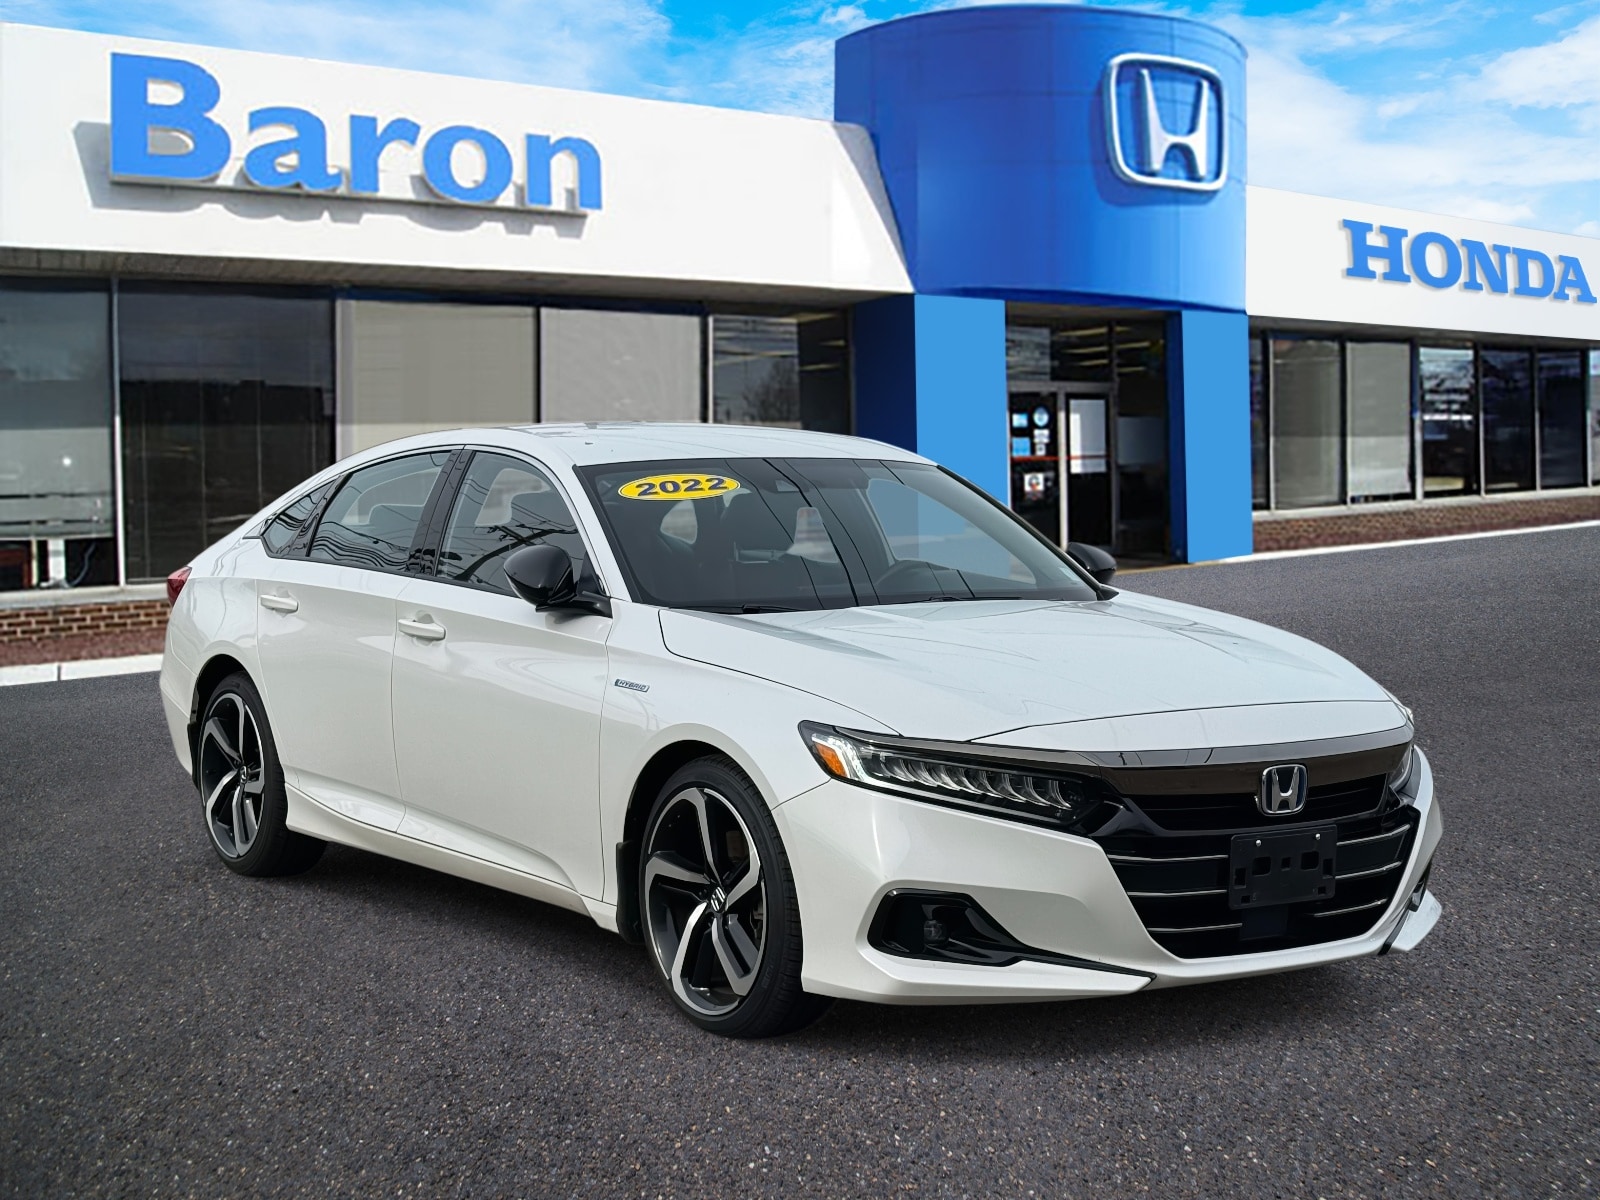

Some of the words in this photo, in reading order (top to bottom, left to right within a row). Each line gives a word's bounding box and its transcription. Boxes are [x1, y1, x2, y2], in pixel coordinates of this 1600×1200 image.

[110, 51, 602, 210] Baron
[1342, 218, 1598, 304] HONDA
[635, 477, 730, 497] 2022
[618, 680, 647, 691] HYBRID
